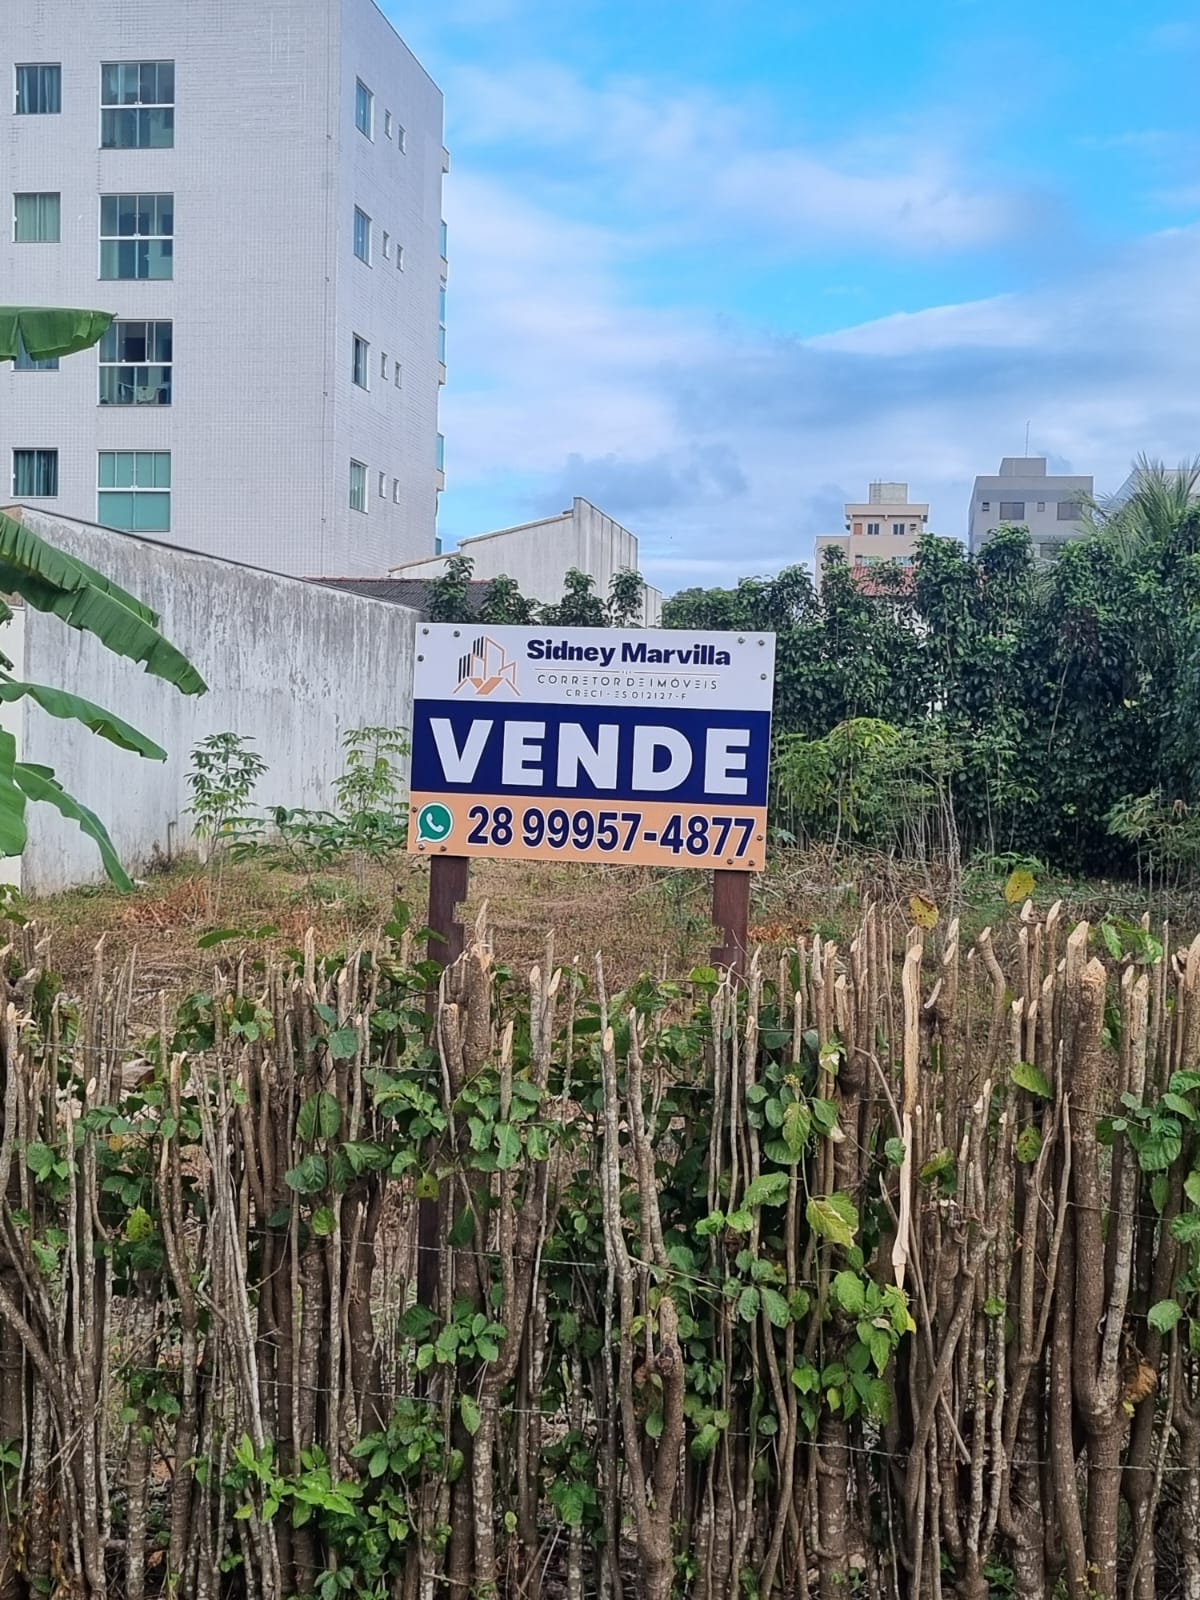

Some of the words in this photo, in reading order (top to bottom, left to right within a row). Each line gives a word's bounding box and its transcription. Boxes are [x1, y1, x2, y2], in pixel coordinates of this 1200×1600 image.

[527, 639, 616, 667] Sidney
[621, 642, 731, 666] Marvilla
[537, 674, 621, 686] CORRETOR
[626, 678, 645, 687] DE
[650, 677, 718, 690] IMÓVEIS
[429, 718, 750, 795] VENDE
[467, 806, 513, 846] 28
[522, 808, 756, 857] 99957-4877
